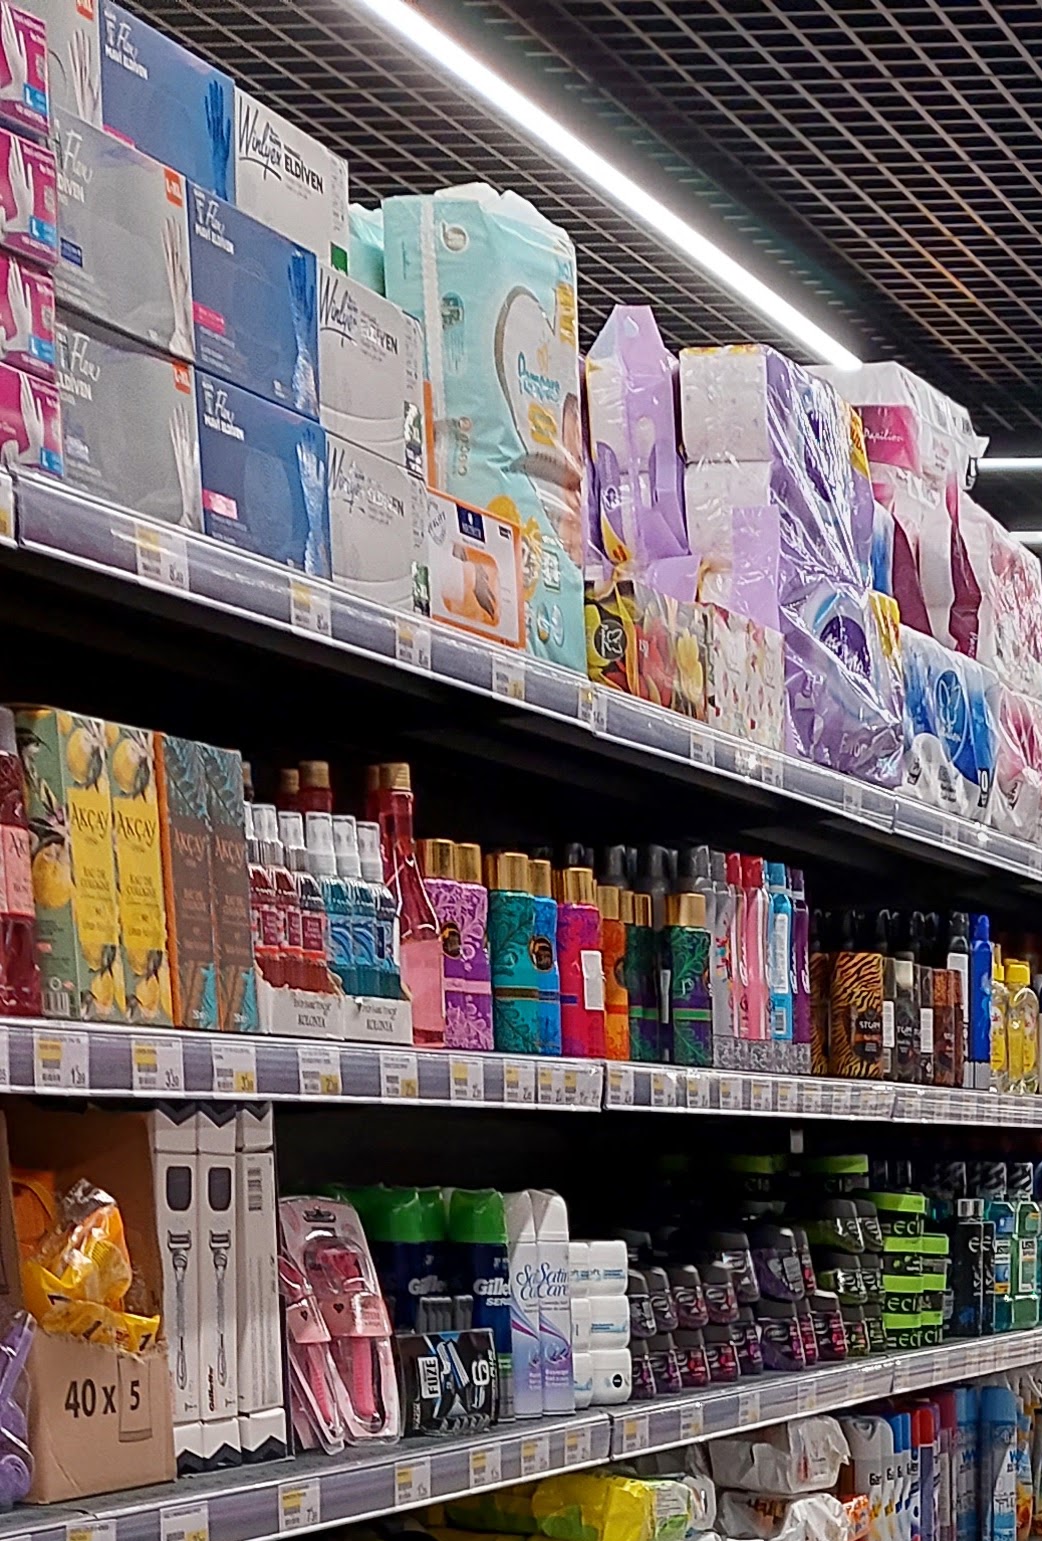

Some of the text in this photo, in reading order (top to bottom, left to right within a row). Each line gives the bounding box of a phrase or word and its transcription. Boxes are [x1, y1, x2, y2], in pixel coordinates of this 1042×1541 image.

[64, 1378, 142, 1419] 40 x 5
